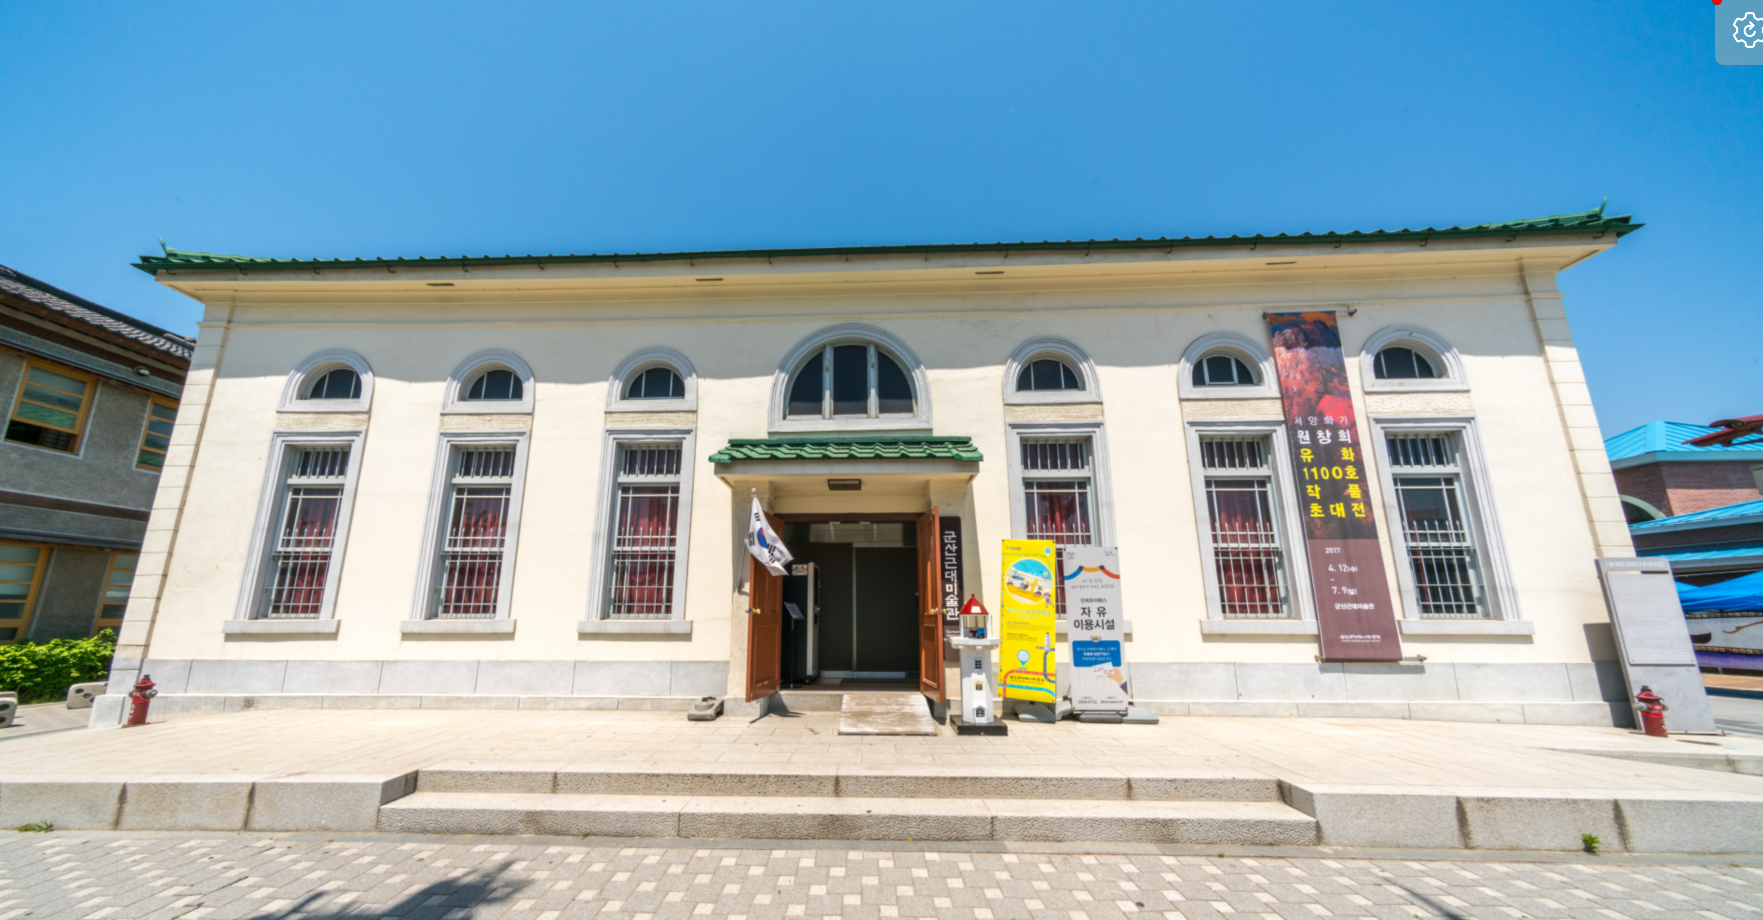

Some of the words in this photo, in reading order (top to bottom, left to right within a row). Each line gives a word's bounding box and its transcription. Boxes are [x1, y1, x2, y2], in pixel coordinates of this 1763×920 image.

[1303, 465, 1359, 480] 1100호
[943, 530, 959, 621] 군산근대미술관
[1073, 619, 1115, 631] 이용시설
